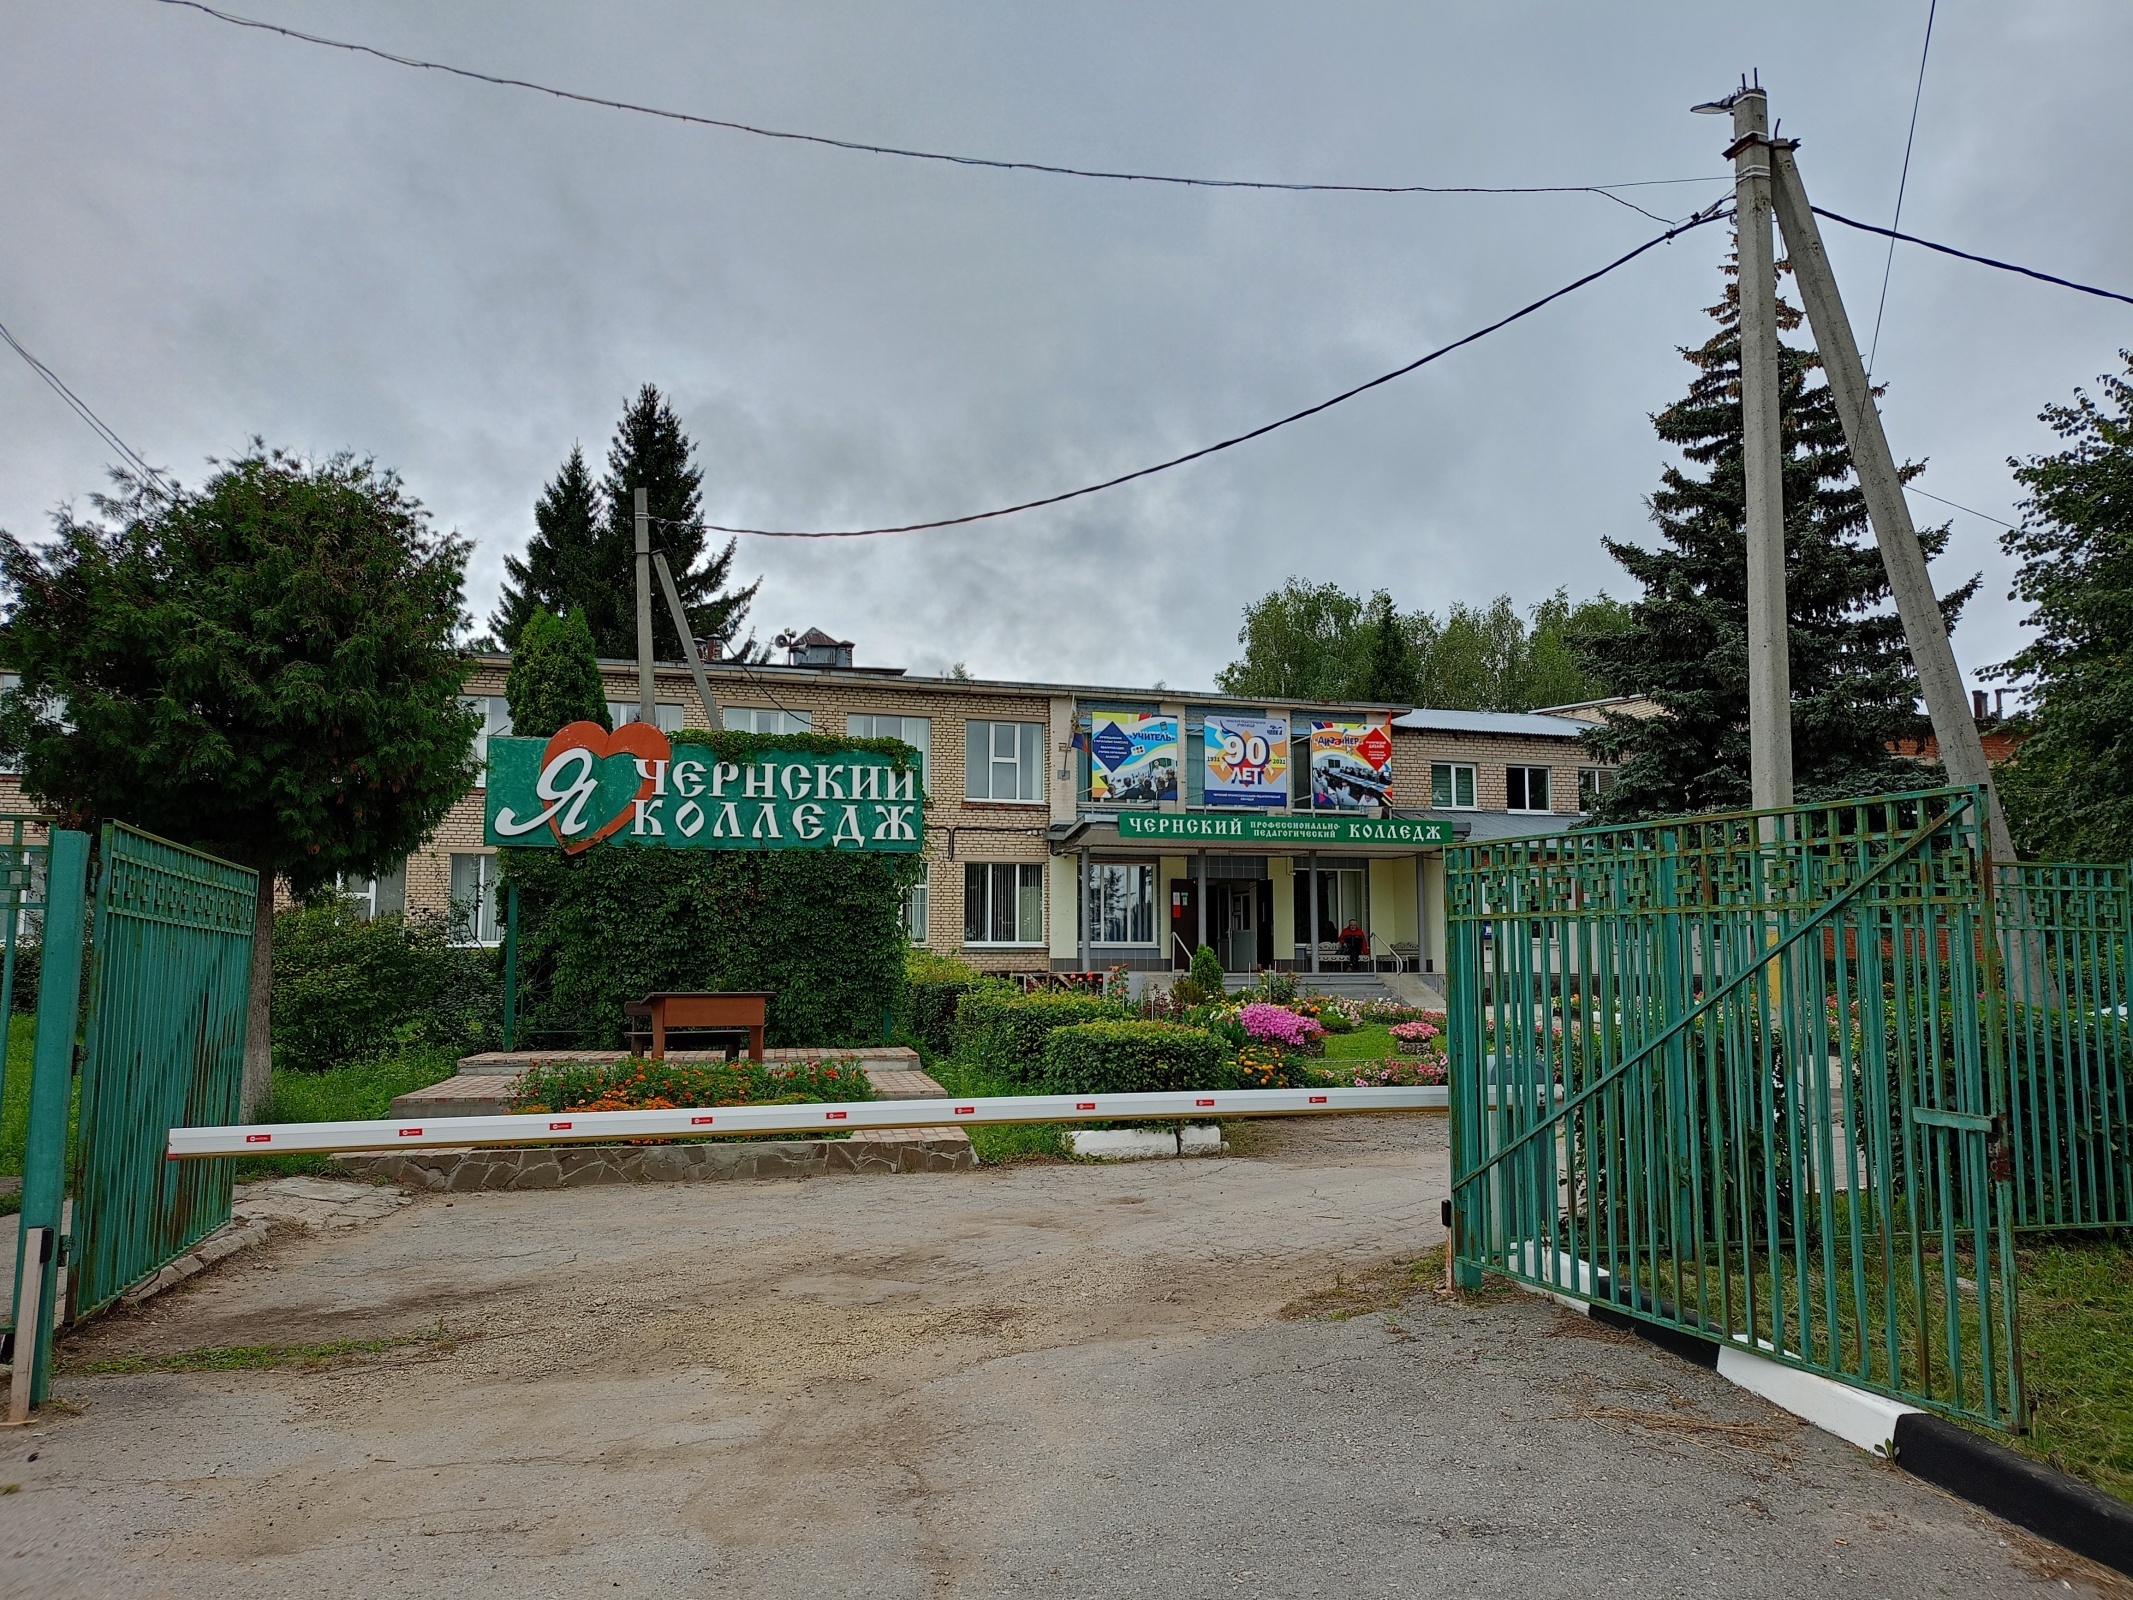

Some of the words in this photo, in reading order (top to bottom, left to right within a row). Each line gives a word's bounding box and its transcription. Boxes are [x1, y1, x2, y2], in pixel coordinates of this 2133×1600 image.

[1223, 735, 1270, 767] 90
[1231, 767, 1264, 785] ЛЕТ
[494, 747, 599, 836] Я
[631, 799, 918, 848] КОЛЛЕДЖ
[1128, 817, 1243, 835] ЧЕРНСКИЙ
[1250, 821, 1341, 830] ПРОФЕССИОНАЛЬНО-
[1349, 823, 1442, 842] КОЛЛЕДЖ
[1253, 829, 1336, 838] ПЕДАГОГИЧЕСКИЙ
